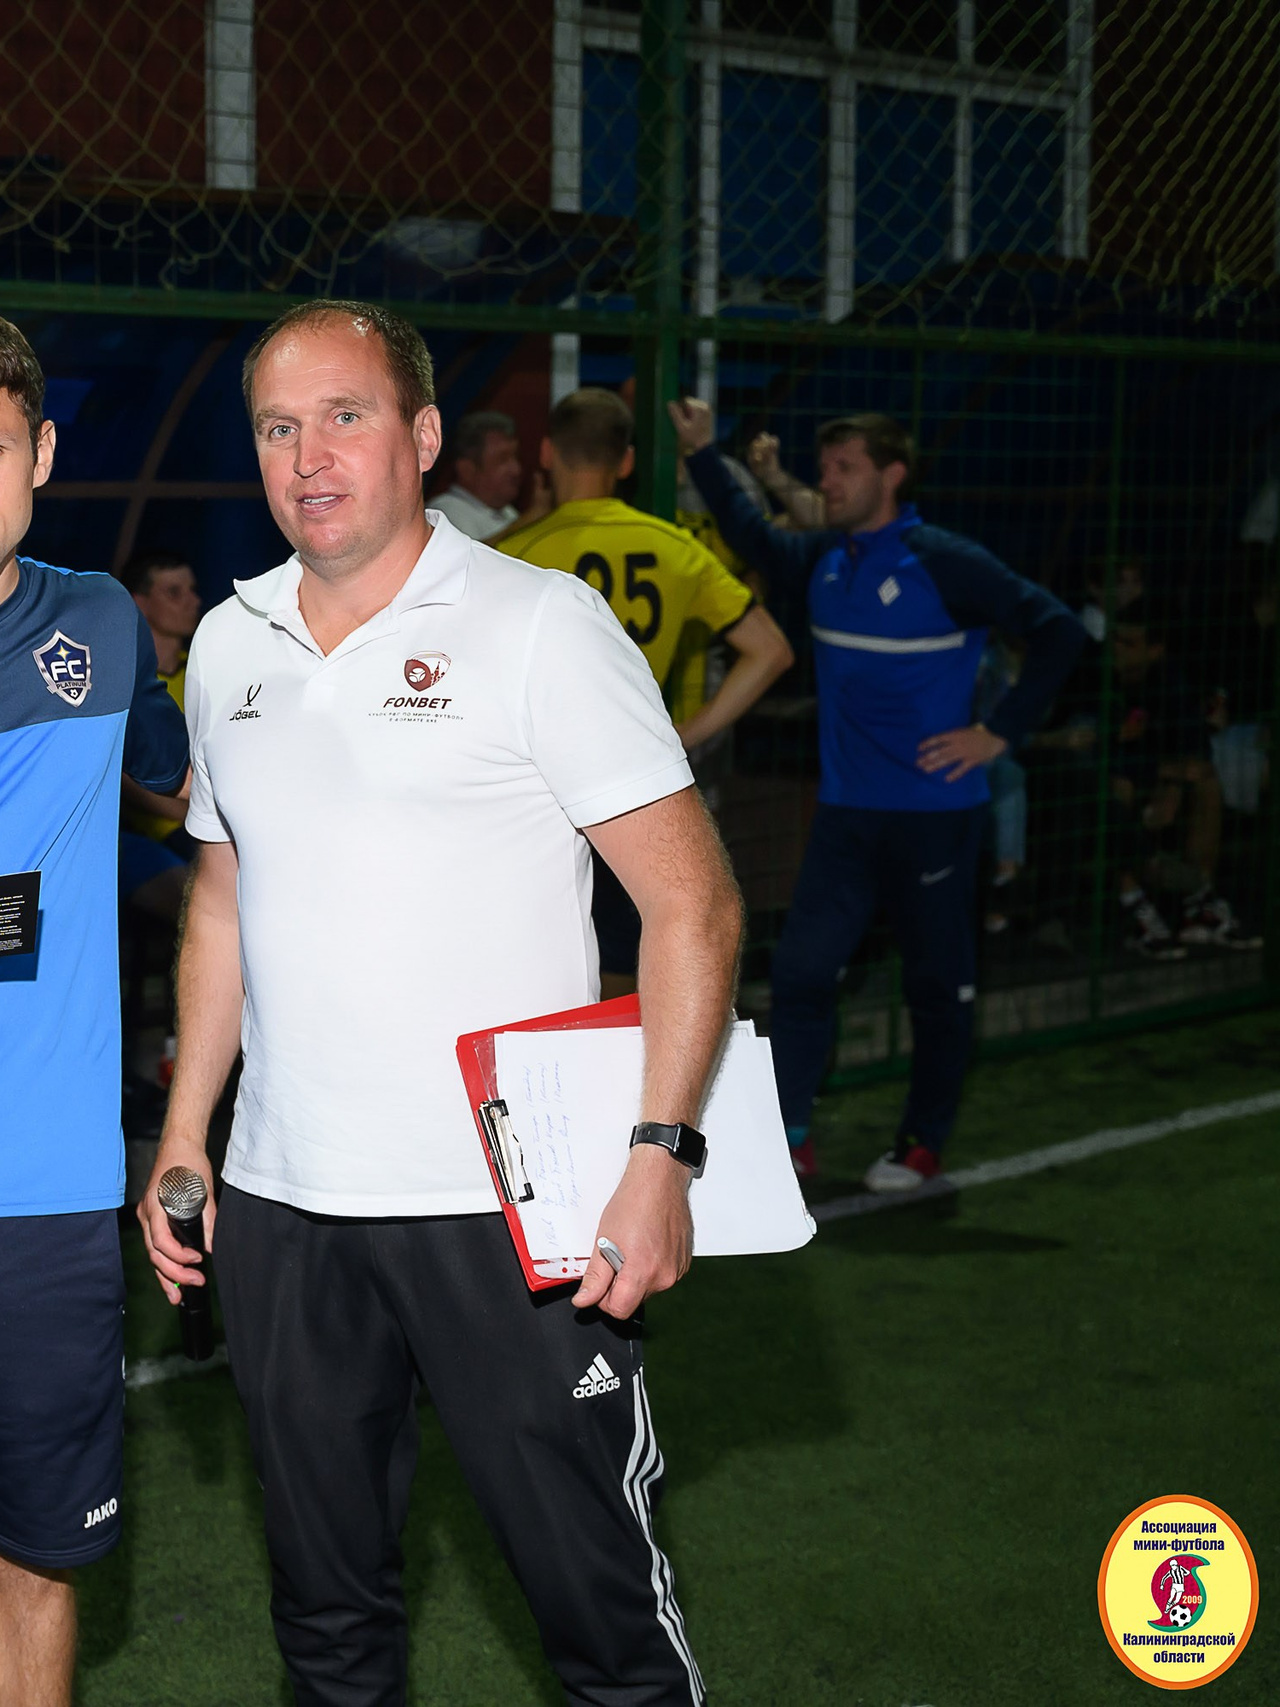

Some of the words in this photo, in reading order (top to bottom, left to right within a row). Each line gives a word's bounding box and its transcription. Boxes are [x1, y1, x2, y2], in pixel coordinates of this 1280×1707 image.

[50, 659, 85, 681] FC
[56, 681, 87, 690] PLATINUM
[383, 697, 452, 709] FONBET
[572, 1376, 621, 1399] adidas
[84, 1497, 117, 1528] JAKO
